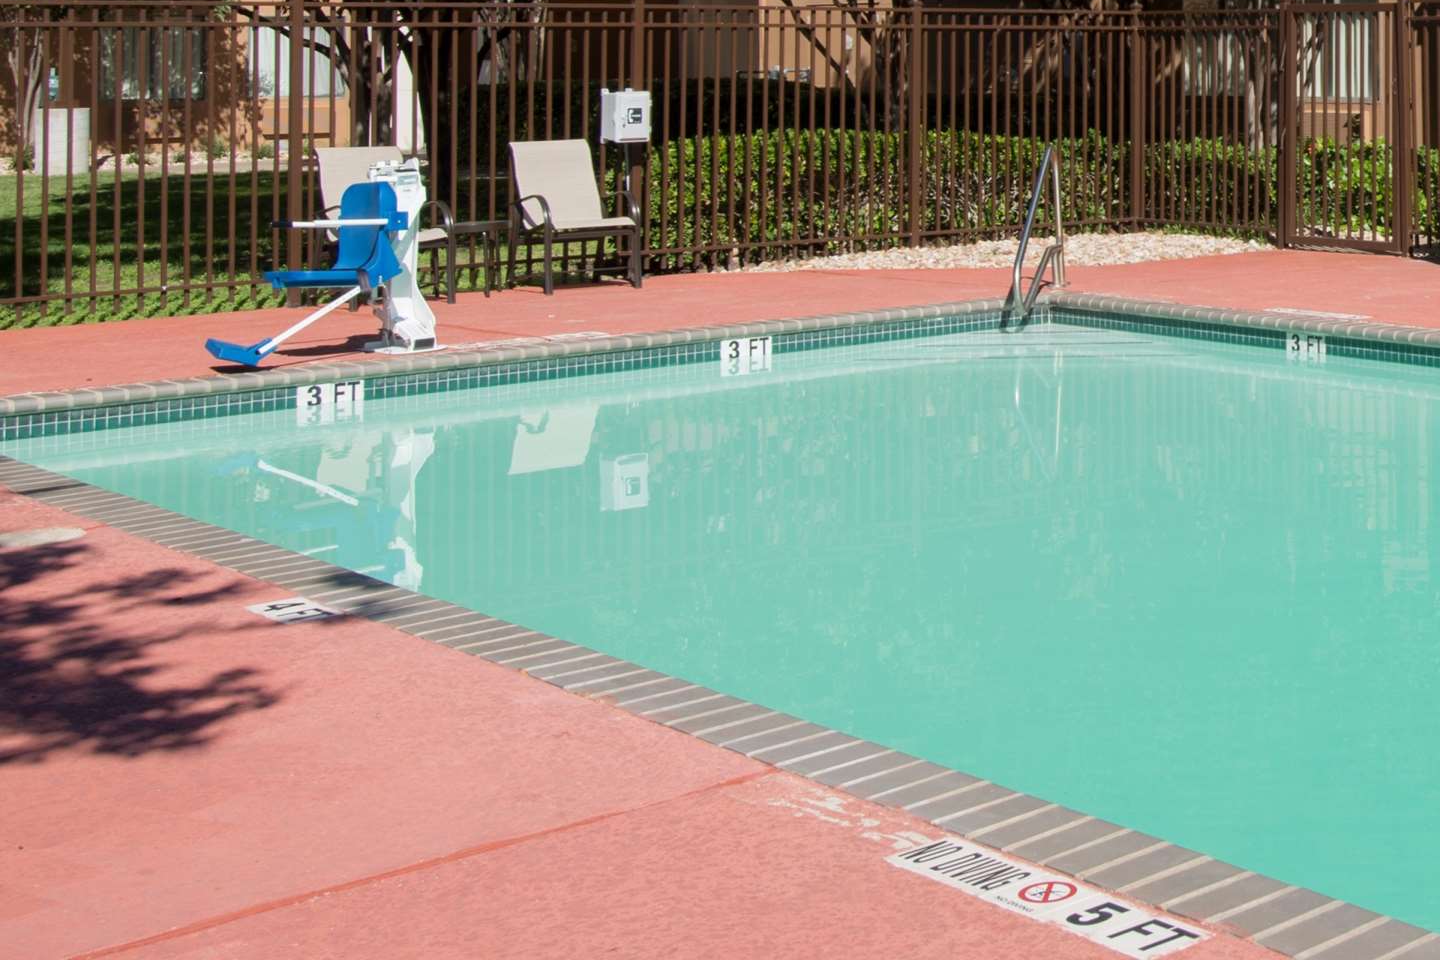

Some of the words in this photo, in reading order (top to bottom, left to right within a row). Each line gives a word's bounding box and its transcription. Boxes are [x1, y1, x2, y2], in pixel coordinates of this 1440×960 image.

[728, 340, 740, 359] 3
[749, 337, 769, 357] FT
[1291, 334, 1301, 351] 3
[1306, 335, 1323, 353] FT
[307, 385, 322, 406] 3
[334, 381, 361, 403] FT
[264, 602, 306, 612] 4
[277, 608, 335, 622] FT
[898, 840, 963, 864] NO
[930, 852, 1032, 891] DIVING
[1066, 902, 1131, 926] 5
[1106, 918, 1201, 951] FT
